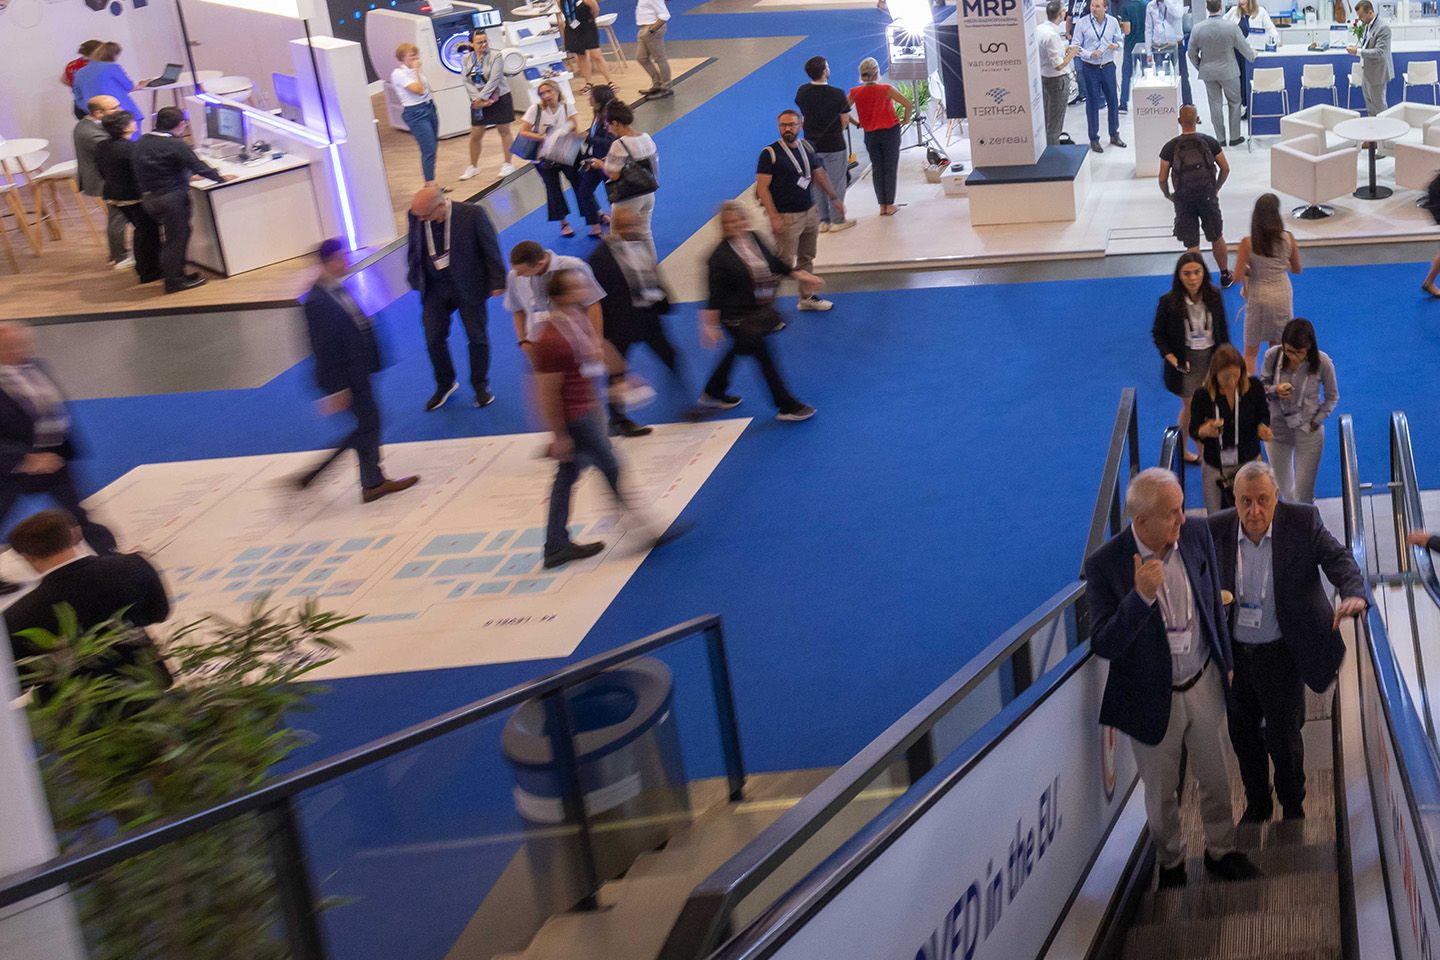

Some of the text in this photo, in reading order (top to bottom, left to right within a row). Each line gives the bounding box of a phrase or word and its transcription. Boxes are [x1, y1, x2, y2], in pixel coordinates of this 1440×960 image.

[985, 59, 1022, 67] overeem
[972, 105, 1026, 117] TERTHERA
[1136, 105, 1176, 117] TERTHERA
[984, 858, 1003, 941] in
[1008, 817, 1035, 906] the
